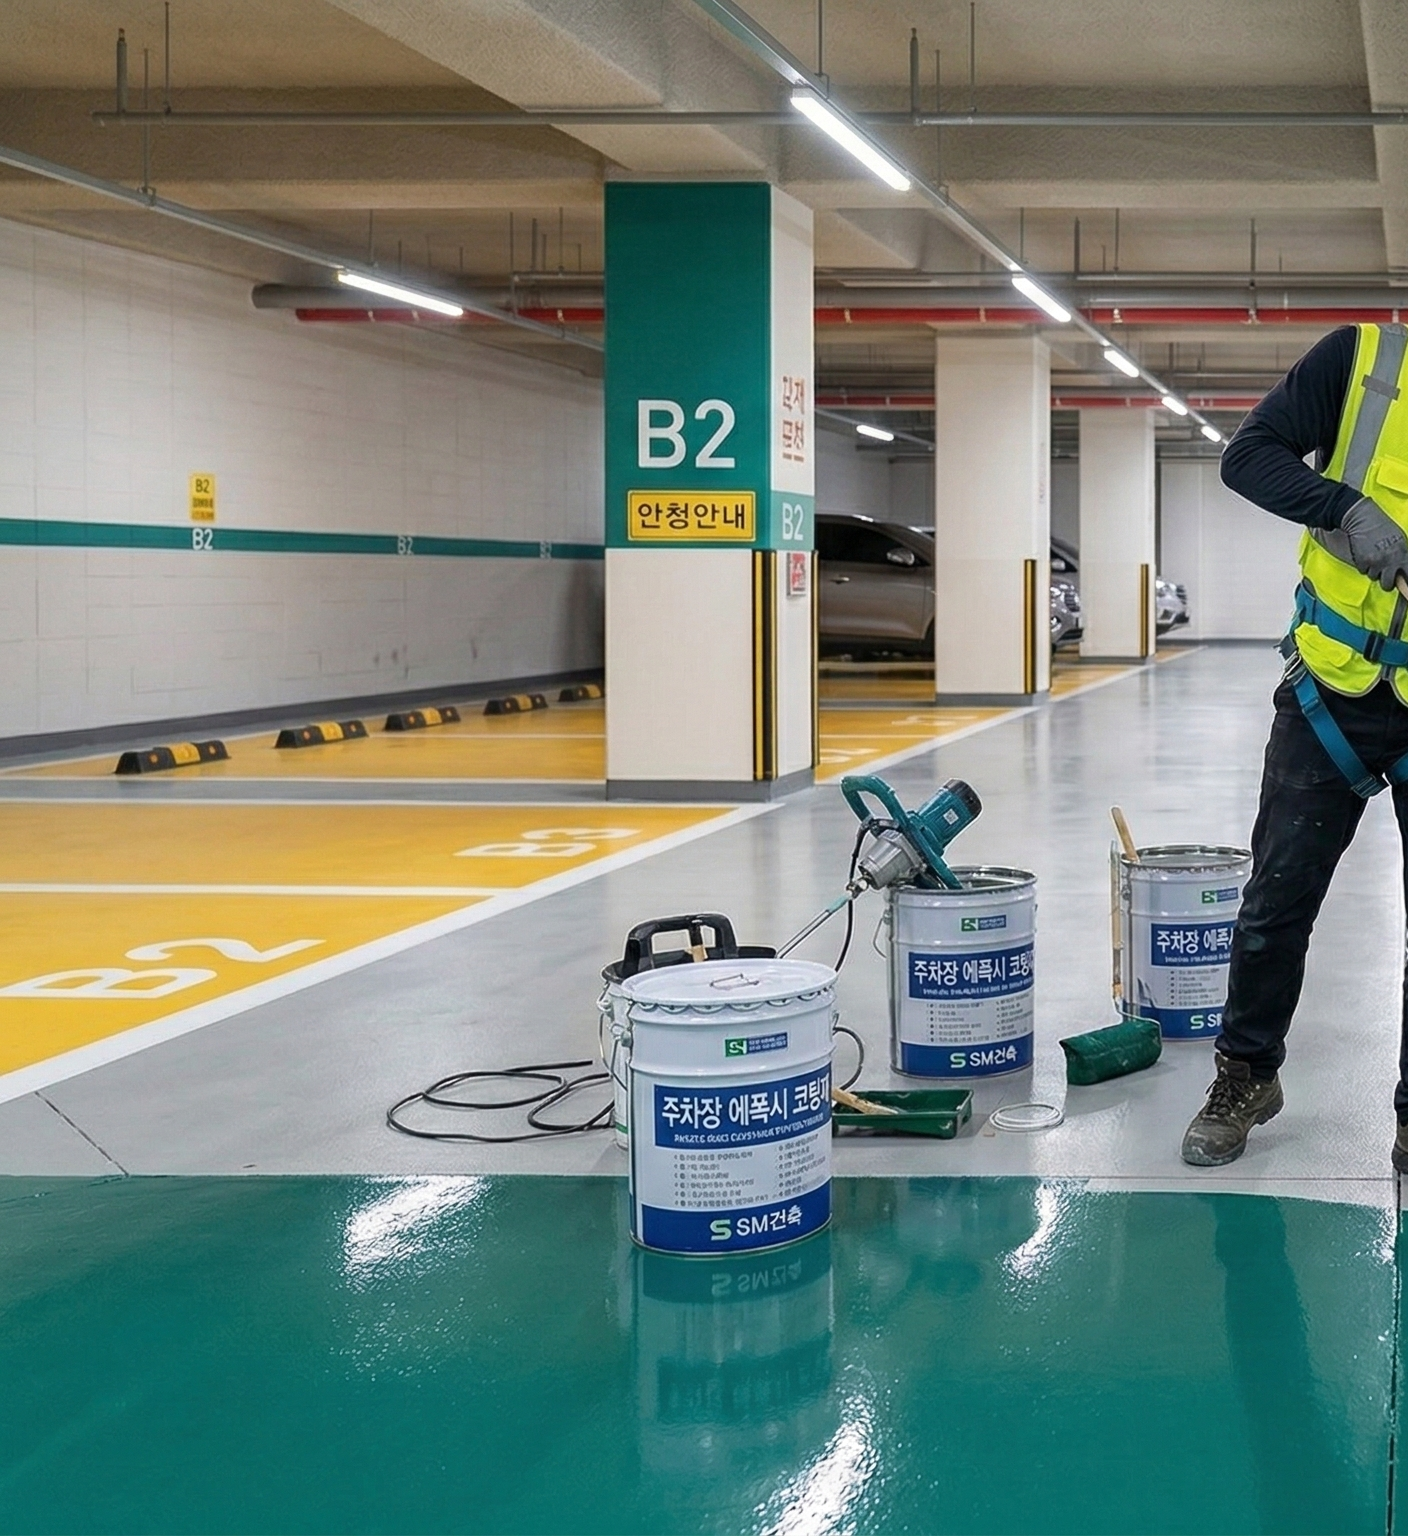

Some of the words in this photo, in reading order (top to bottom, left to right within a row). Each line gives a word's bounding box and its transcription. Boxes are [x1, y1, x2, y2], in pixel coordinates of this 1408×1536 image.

[638, 399, 736, 469] B2
[195, 478, 210, 494] B2
[637, 502, 746, 530] 안청안내
[782, 502, 804, 541] B2
[192, 528, 214, 551] B2
[0, 937, 328, 999] B2
[914, 960, 959, 986] 주차장
[661, 1095, 723, 1130] 주차장
[728, 1088, 788, 1127] 에폭시
